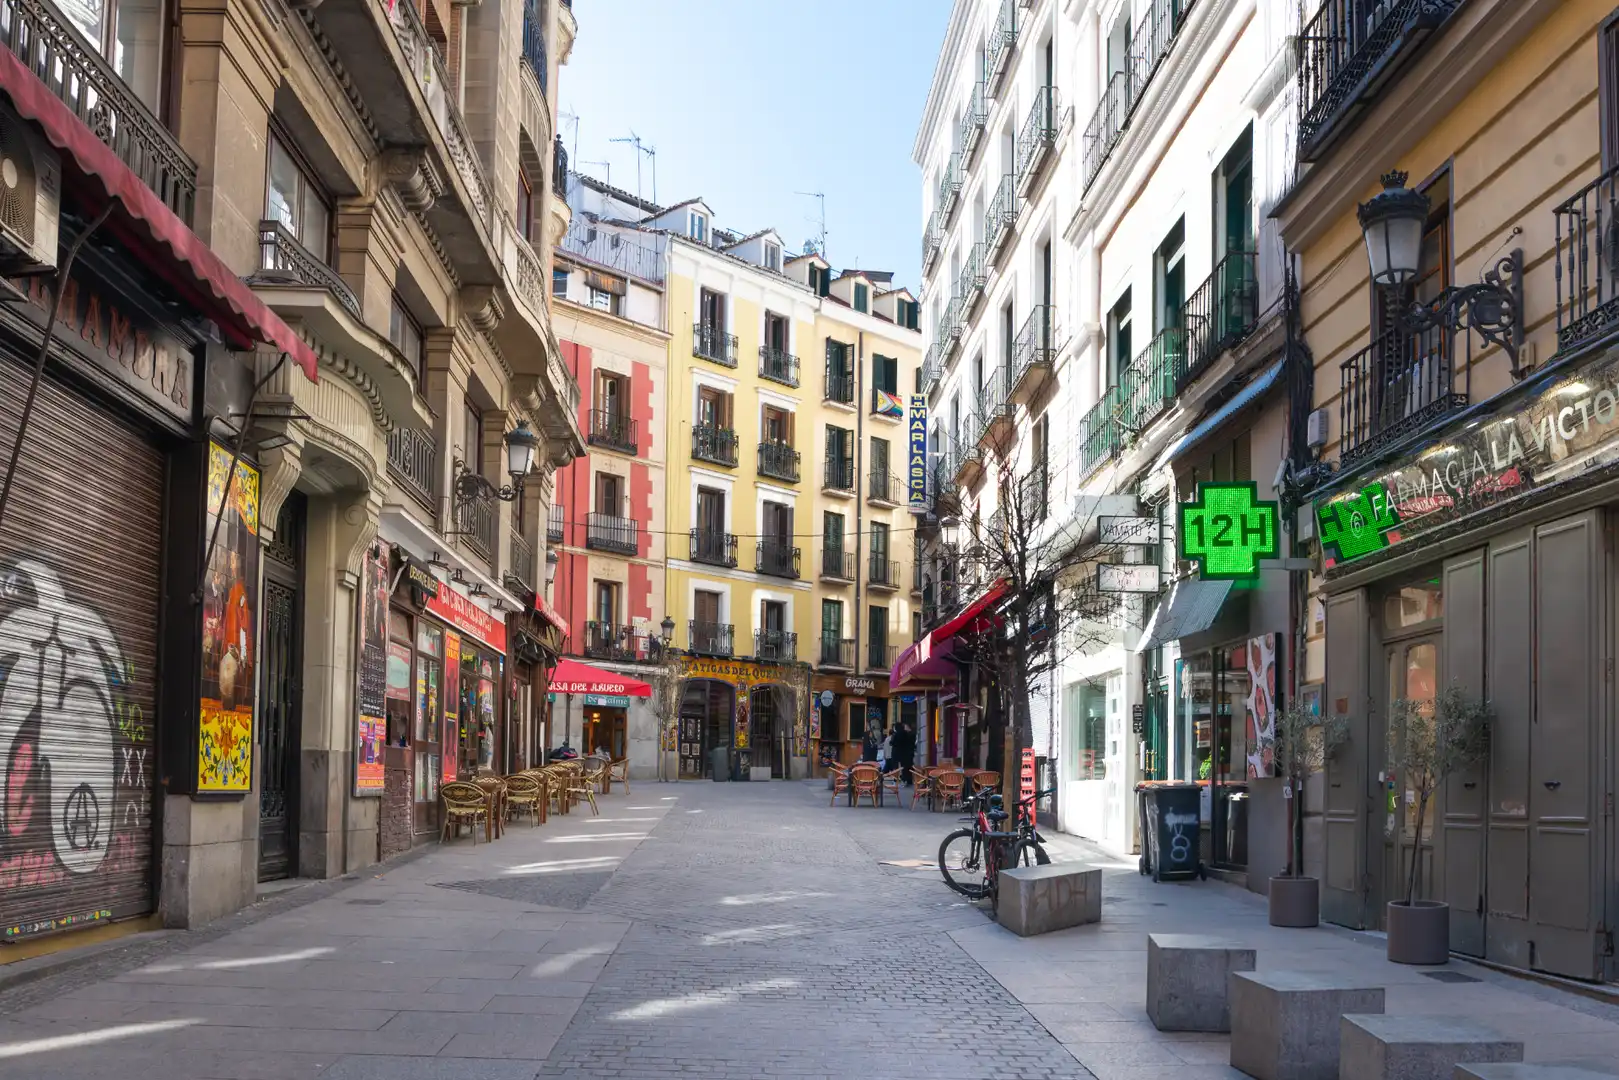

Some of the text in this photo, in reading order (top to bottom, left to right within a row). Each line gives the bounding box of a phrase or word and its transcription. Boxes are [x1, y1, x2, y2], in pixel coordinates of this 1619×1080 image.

[910, 408, 926, 502] MARLASCA
[1373, 450, 1487, 519] FARMACIA
[1490, 431, 1525, 471] LA
[1530, 381, 1619, 453] VICTO
[1190, 513, 1267, 548] 12H
[732, 667, 751, 677] DEL
[548, 681, 625, 693] ASA DEL ABUELO
[845, 678, 875, 690] GRAMA
